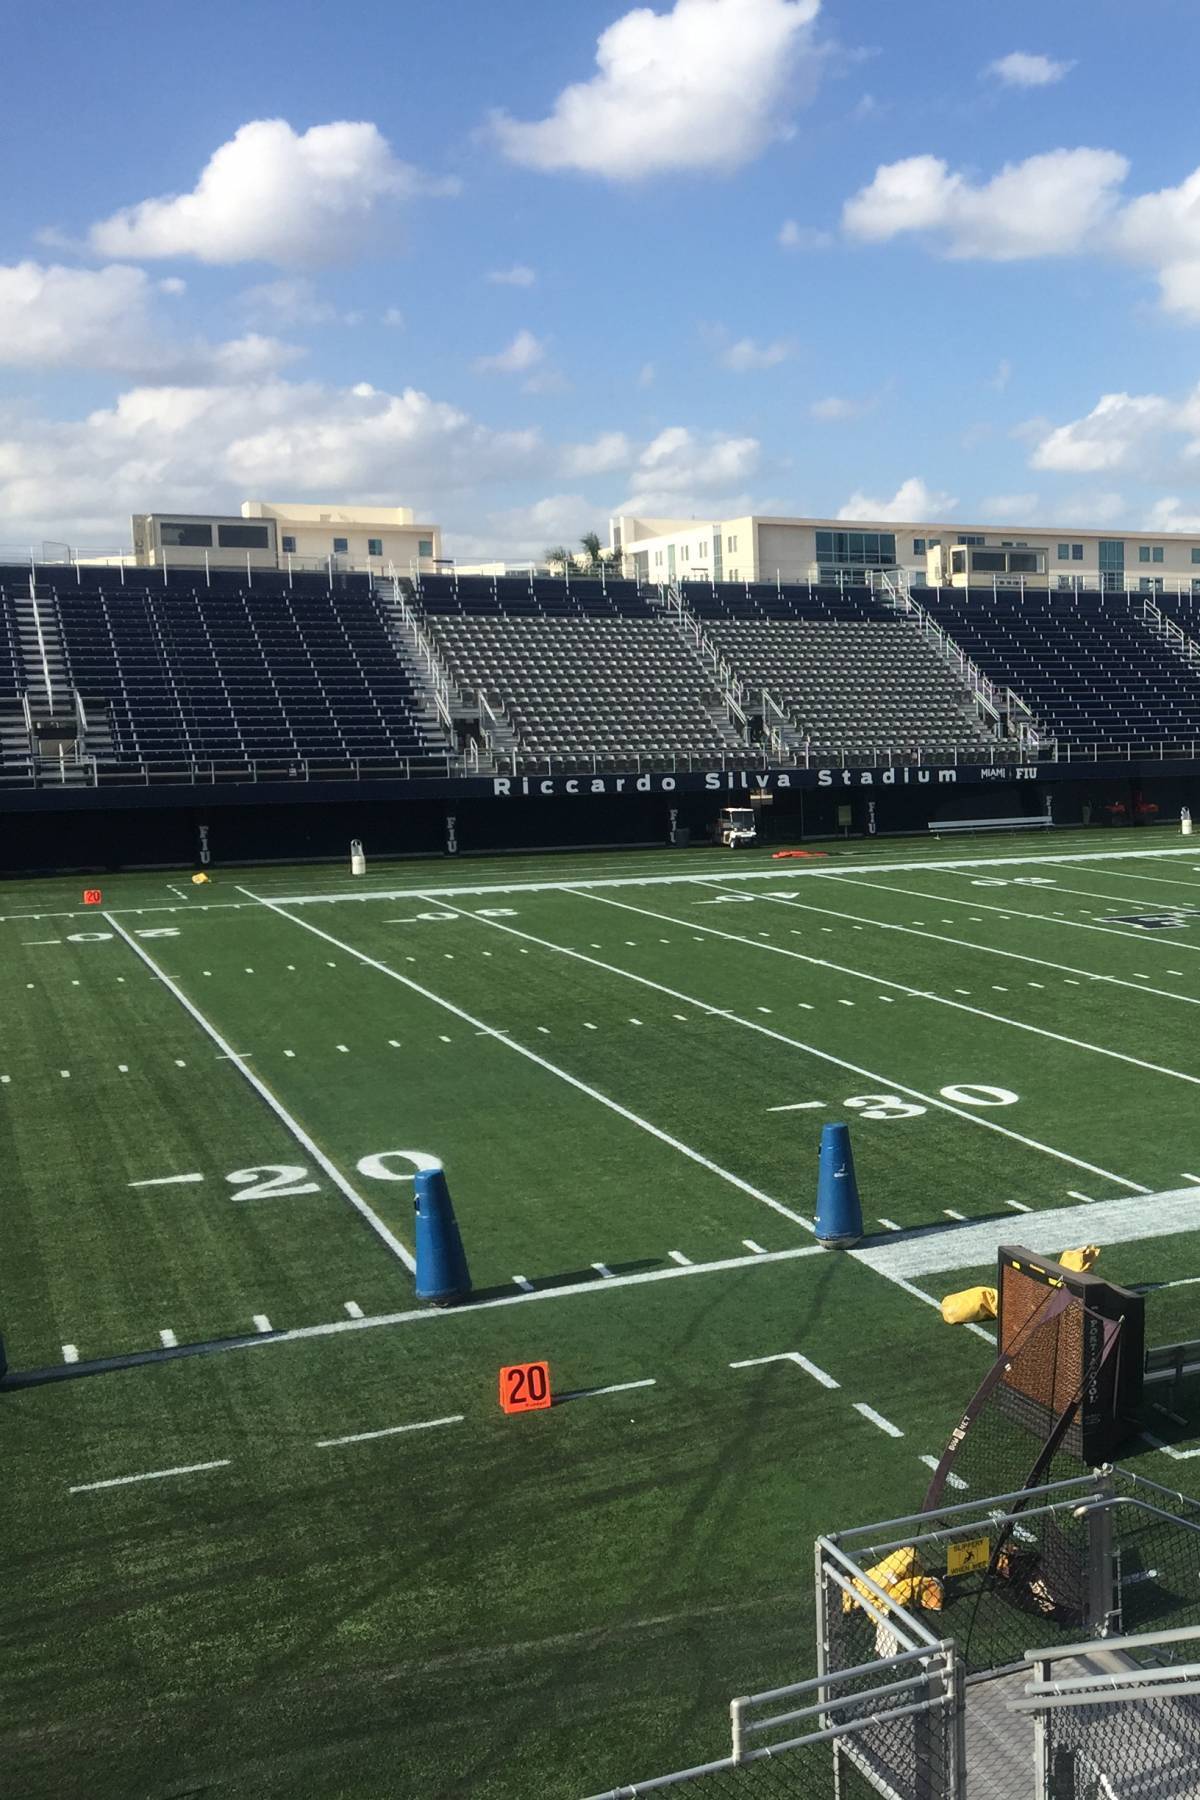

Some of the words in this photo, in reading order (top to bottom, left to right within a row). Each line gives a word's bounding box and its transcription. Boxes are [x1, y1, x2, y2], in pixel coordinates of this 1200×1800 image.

[493, 774, 676, 796] Riccardo
[705, 771, 791, 790] Silva
[818, 767, 957, 786] Stadium
[1016, 767, 1038, 780] FIU
[86, 891, 100, 903] 20
[843, 1084, 1020, 1120] 30
[225, 1150, 444, 1201] 20
[507, 1365, 547, 1405] 20
